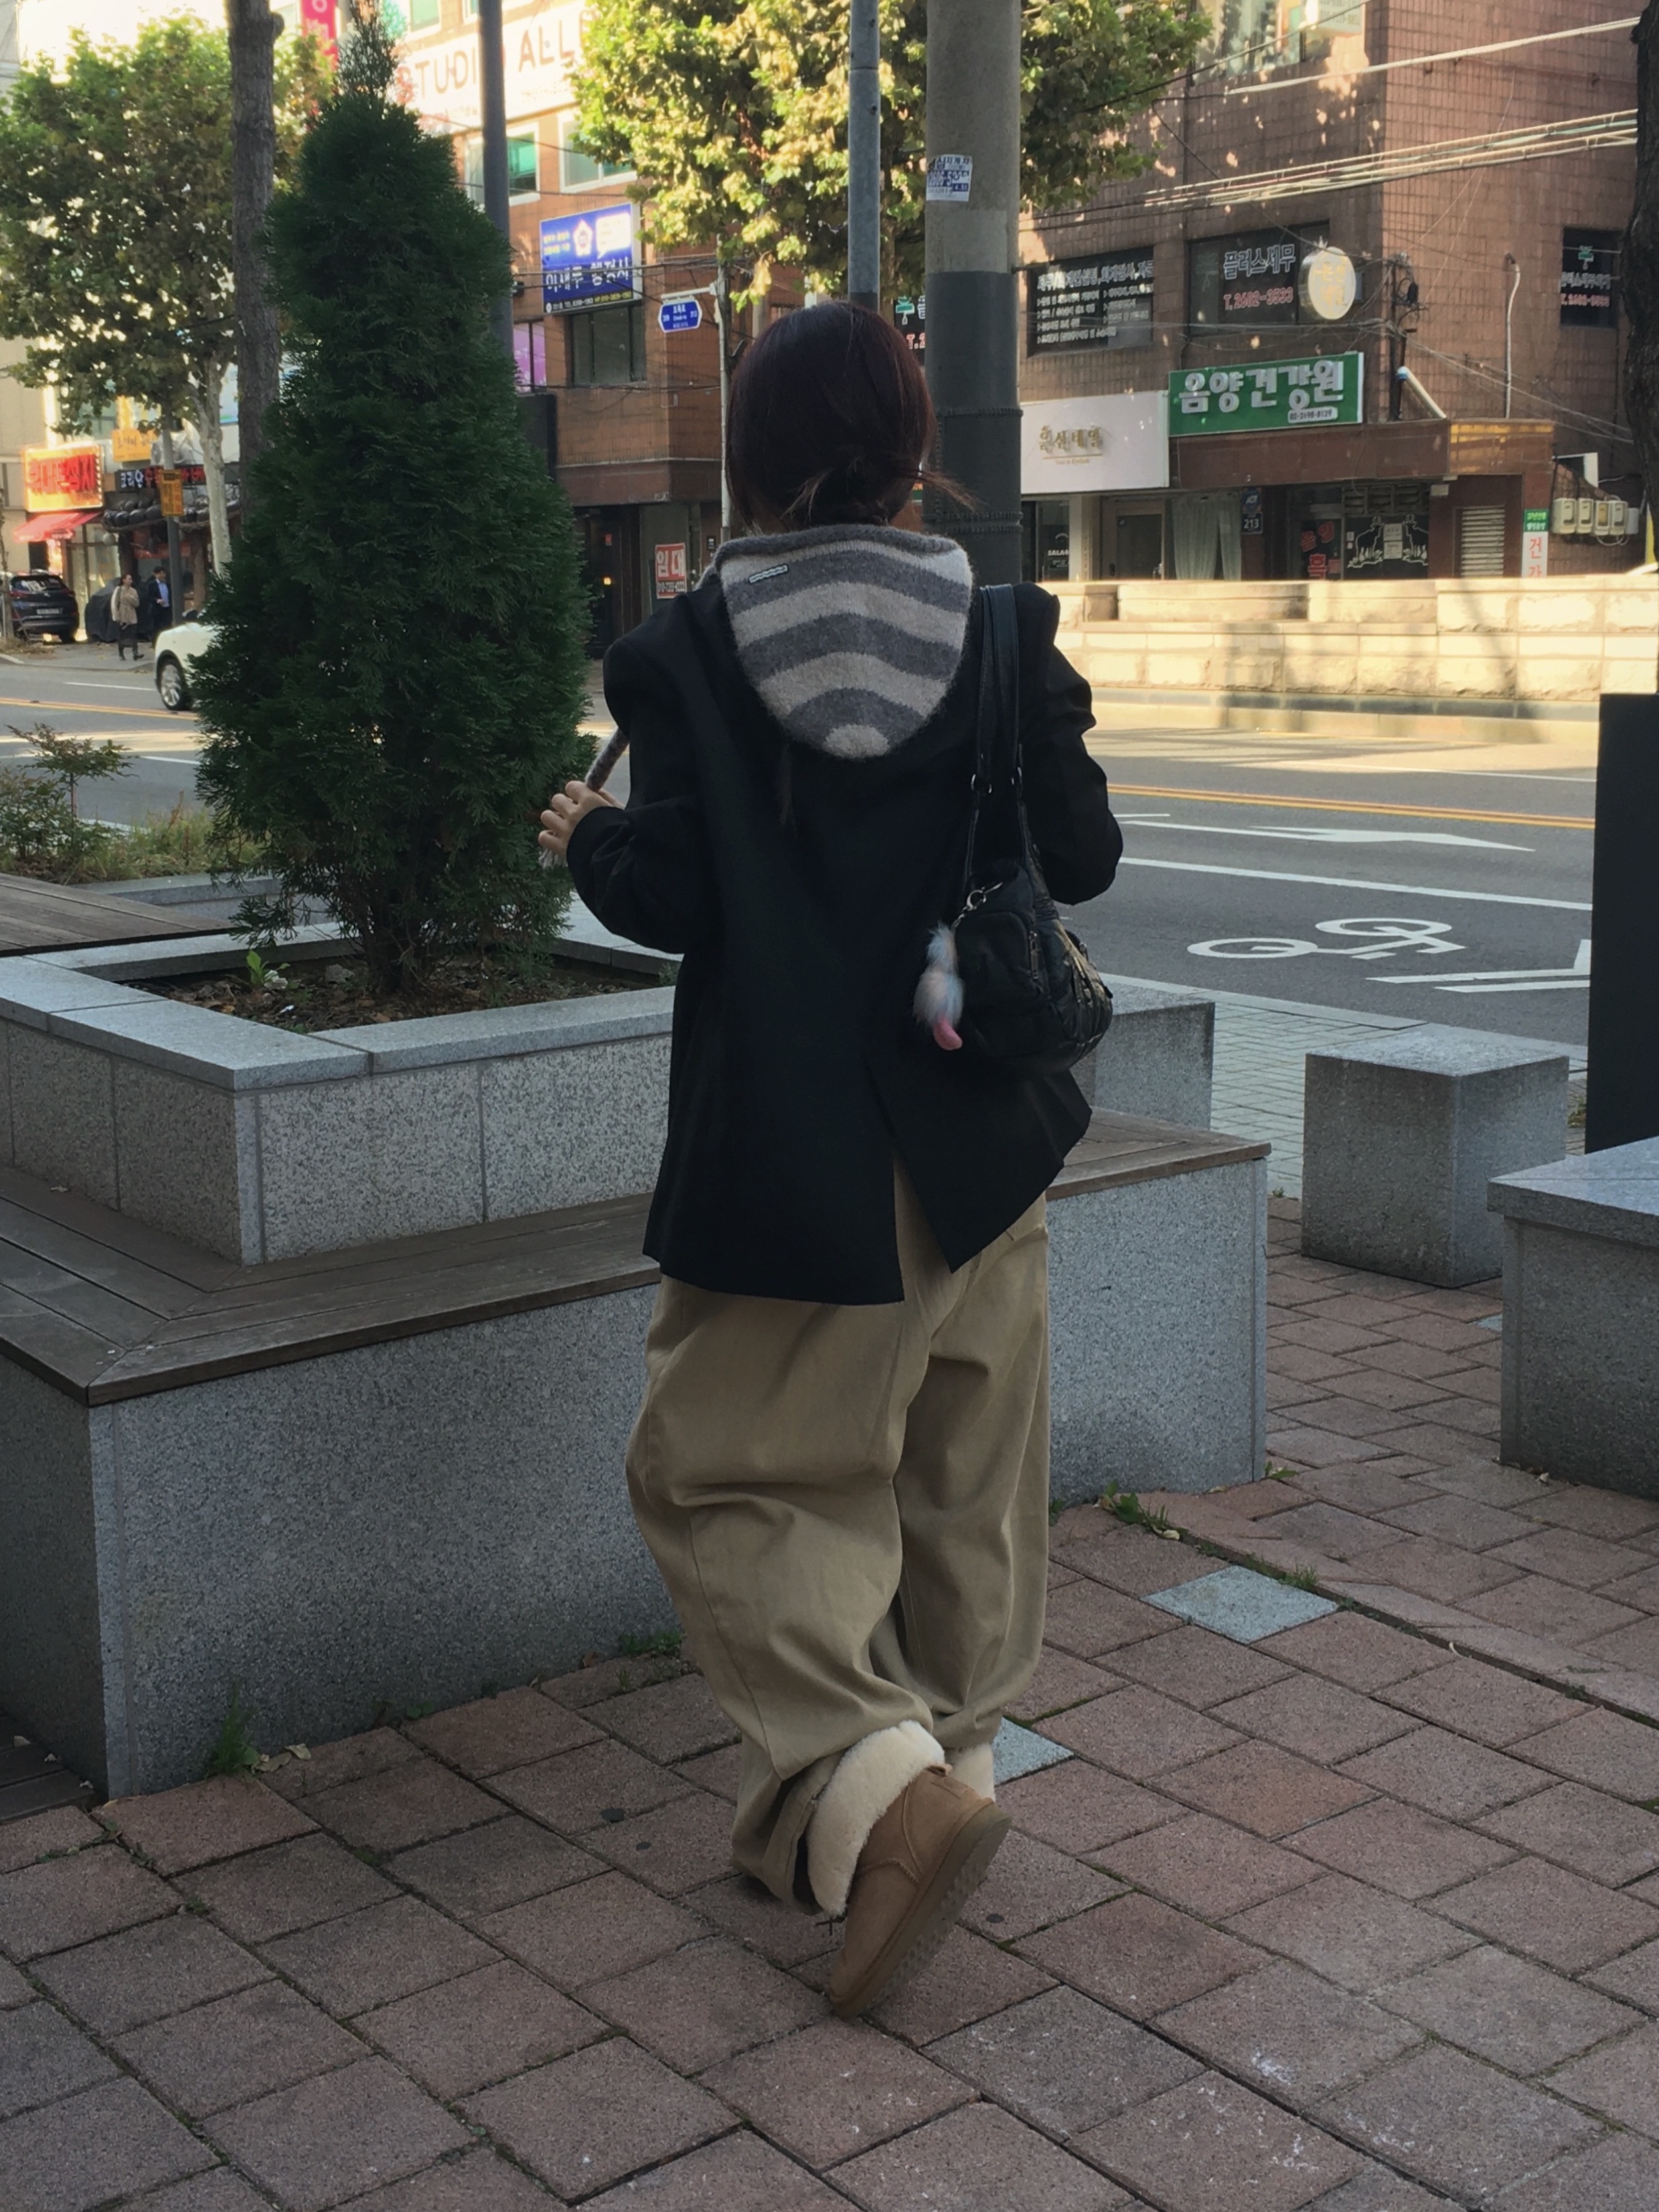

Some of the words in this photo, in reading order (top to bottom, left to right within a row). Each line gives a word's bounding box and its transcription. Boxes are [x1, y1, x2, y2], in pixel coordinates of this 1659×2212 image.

[396, 44, 507, 104] STUDI
[1223, 243, 1296, 280] 플러스세무
[1178, 359, 1344, 414] 음양건강원
[1243, 518, 1259, 529] 213
[657, 550, 686, 578] 임대
